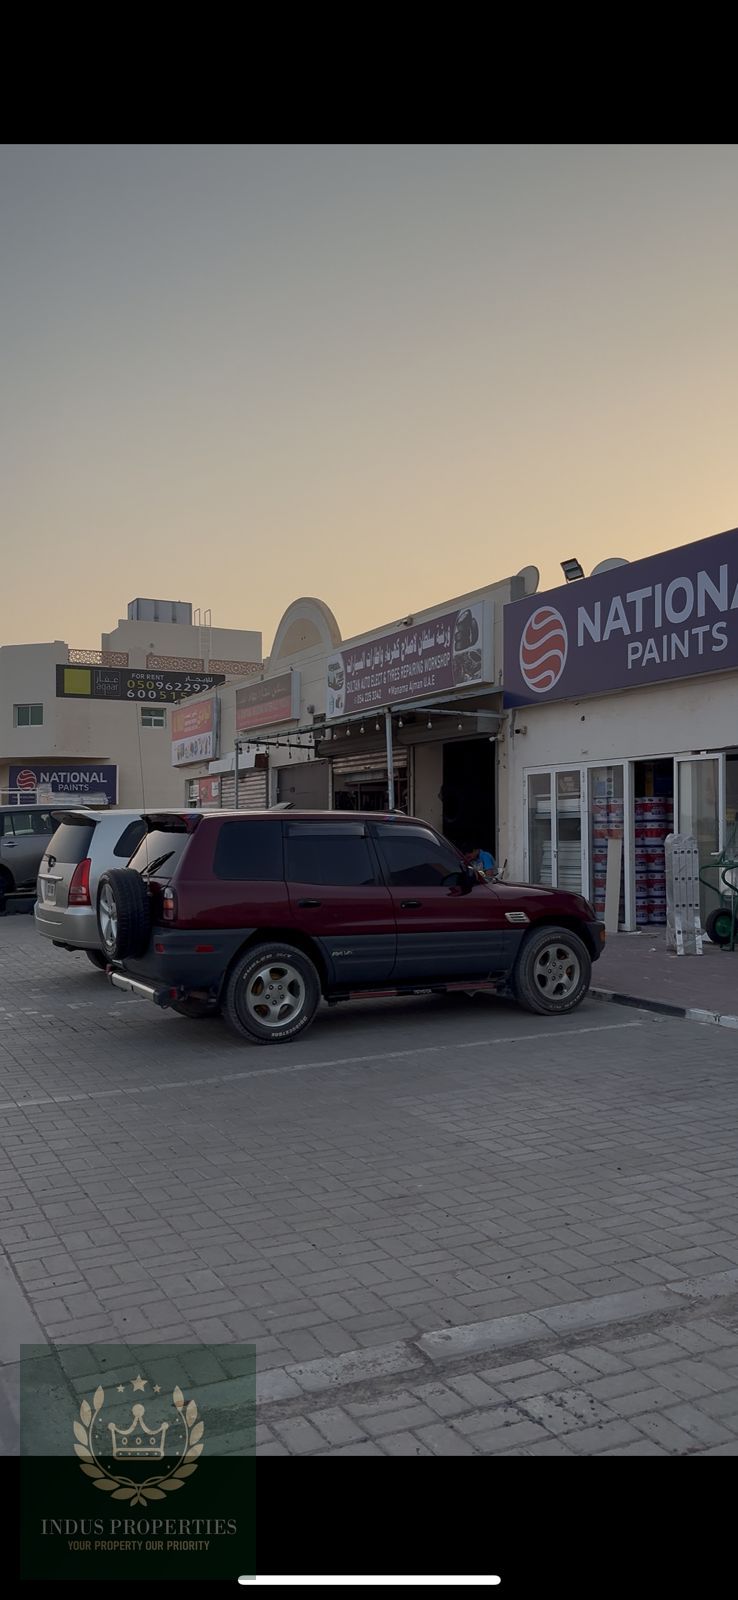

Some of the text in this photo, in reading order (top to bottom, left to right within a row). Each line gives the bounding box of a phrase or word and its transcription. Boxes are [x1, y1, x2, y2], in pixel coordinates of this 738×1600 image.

[577, 563, 738, 647] NATION
[418, 628, 435, 657] سلطان
[436, 624, 451, 648] ورشة
[627, 621, 728, 670] PAINTS
[346, 651, 366, 676] السيارات
[346, 678, 361, 694] SULTAN
[361, 675, 370, 690] AUTO
[370, 672, 383, 688] ELECT
[387, 667, 400, 682] TYRES
[400, 659, 423, 680] REPAIRING
[424, 652, 451, 674] WORKSHOP
[390, 683, 409, 696] Manama
[409, 680, 423, 694] Ajman
[40, 772, 107, 783] NATIONAL
